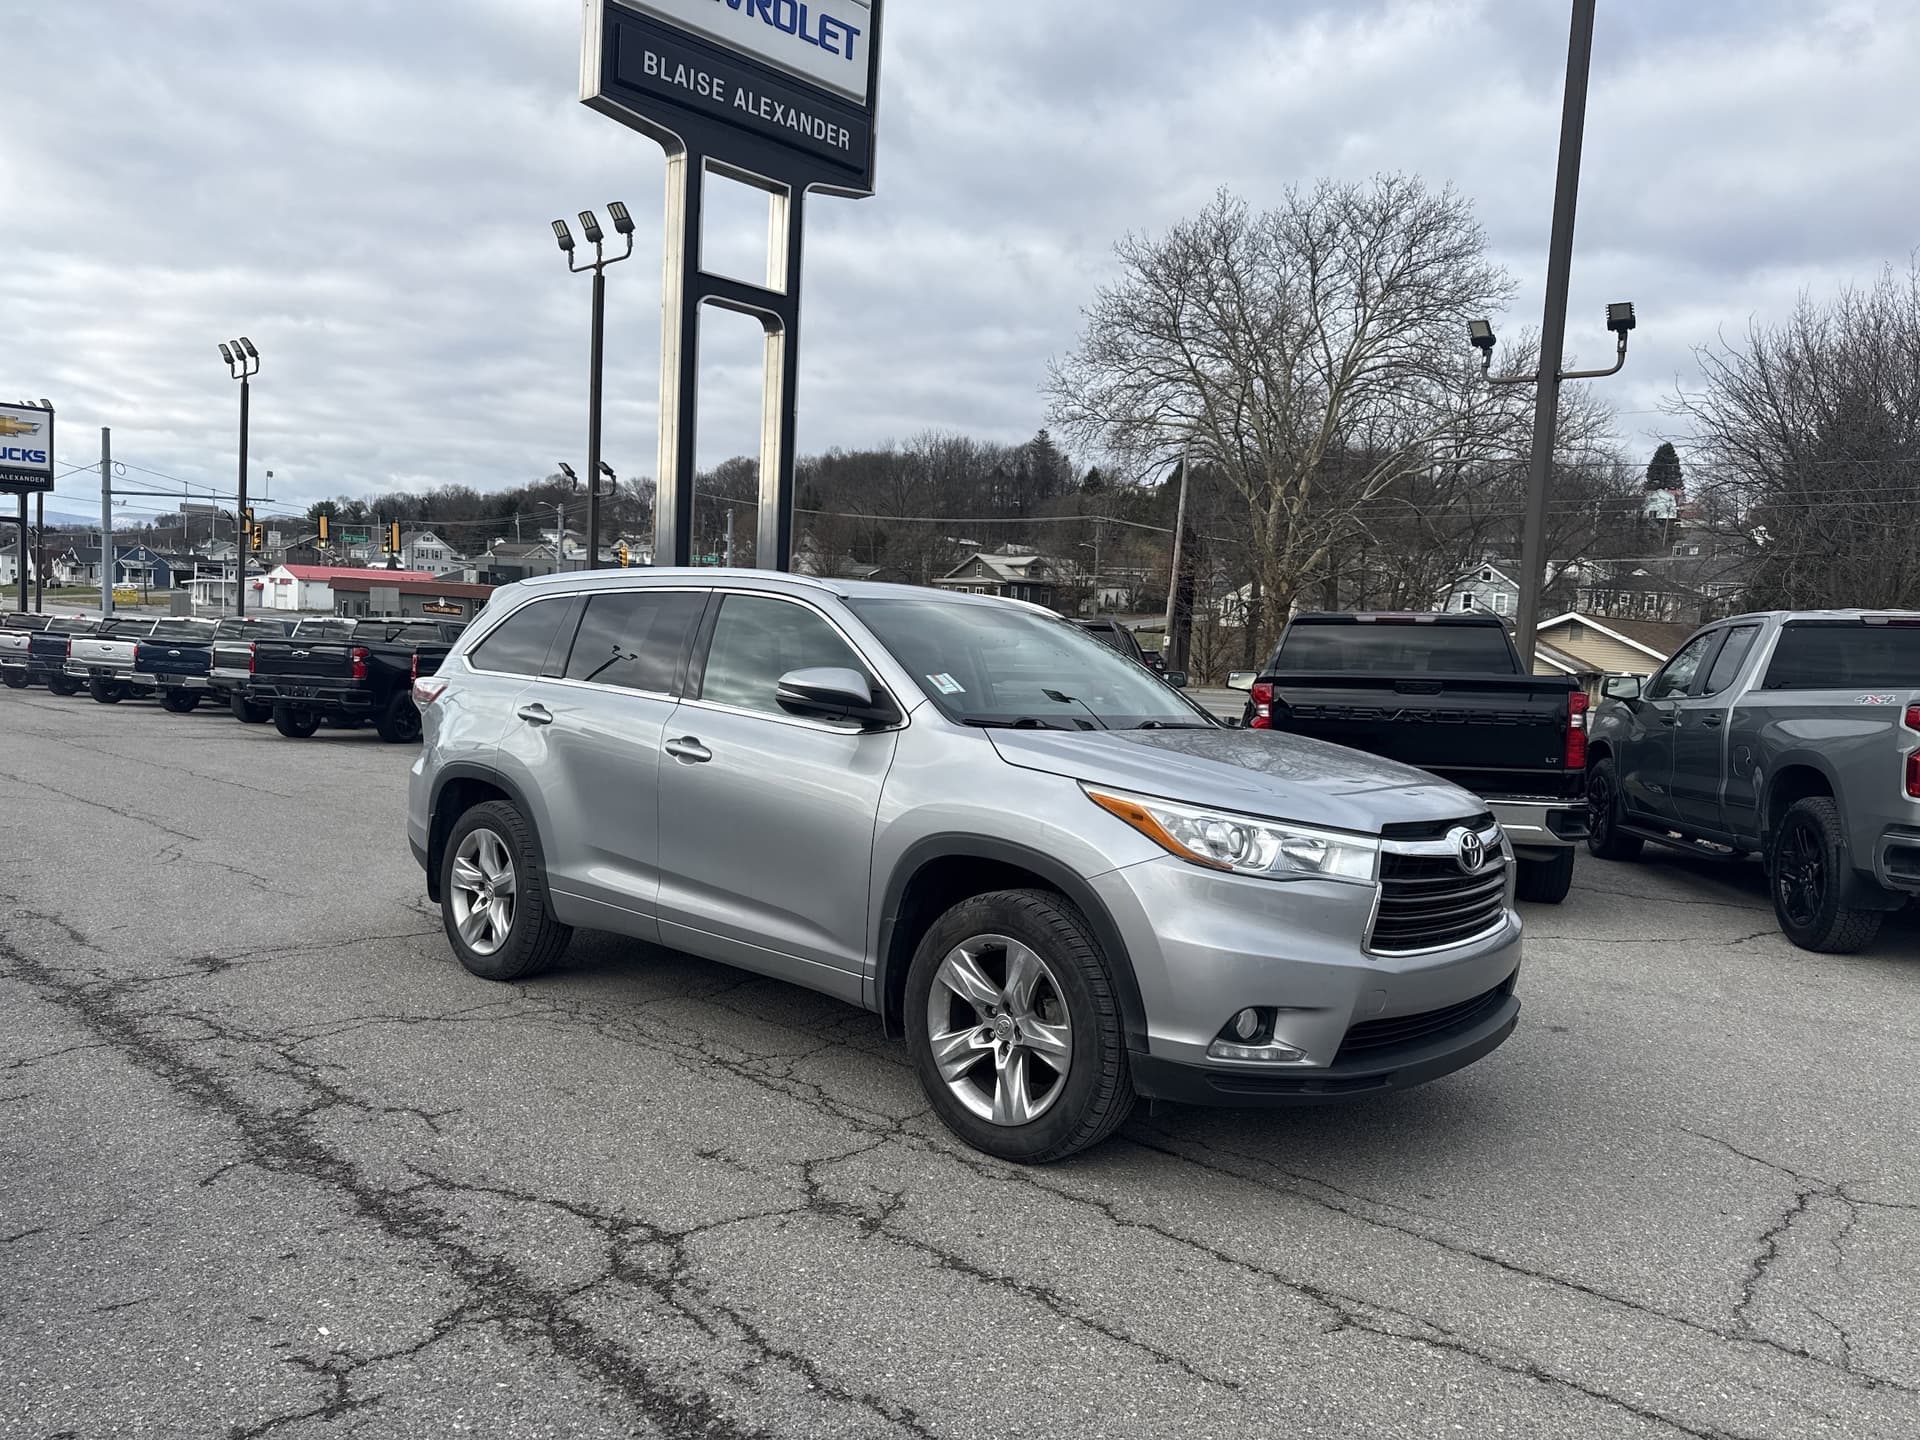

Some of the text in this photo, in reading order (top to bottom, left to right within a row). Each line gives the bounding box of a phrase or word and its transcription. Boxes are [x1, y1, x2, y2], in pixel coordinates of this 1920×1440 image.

[643, 50, 850, 150] BLAISE ALEXANDER
[0, 473, 45, 483] ALEXANDER
[1292, 704, 1553, 726] CHEVROLET
